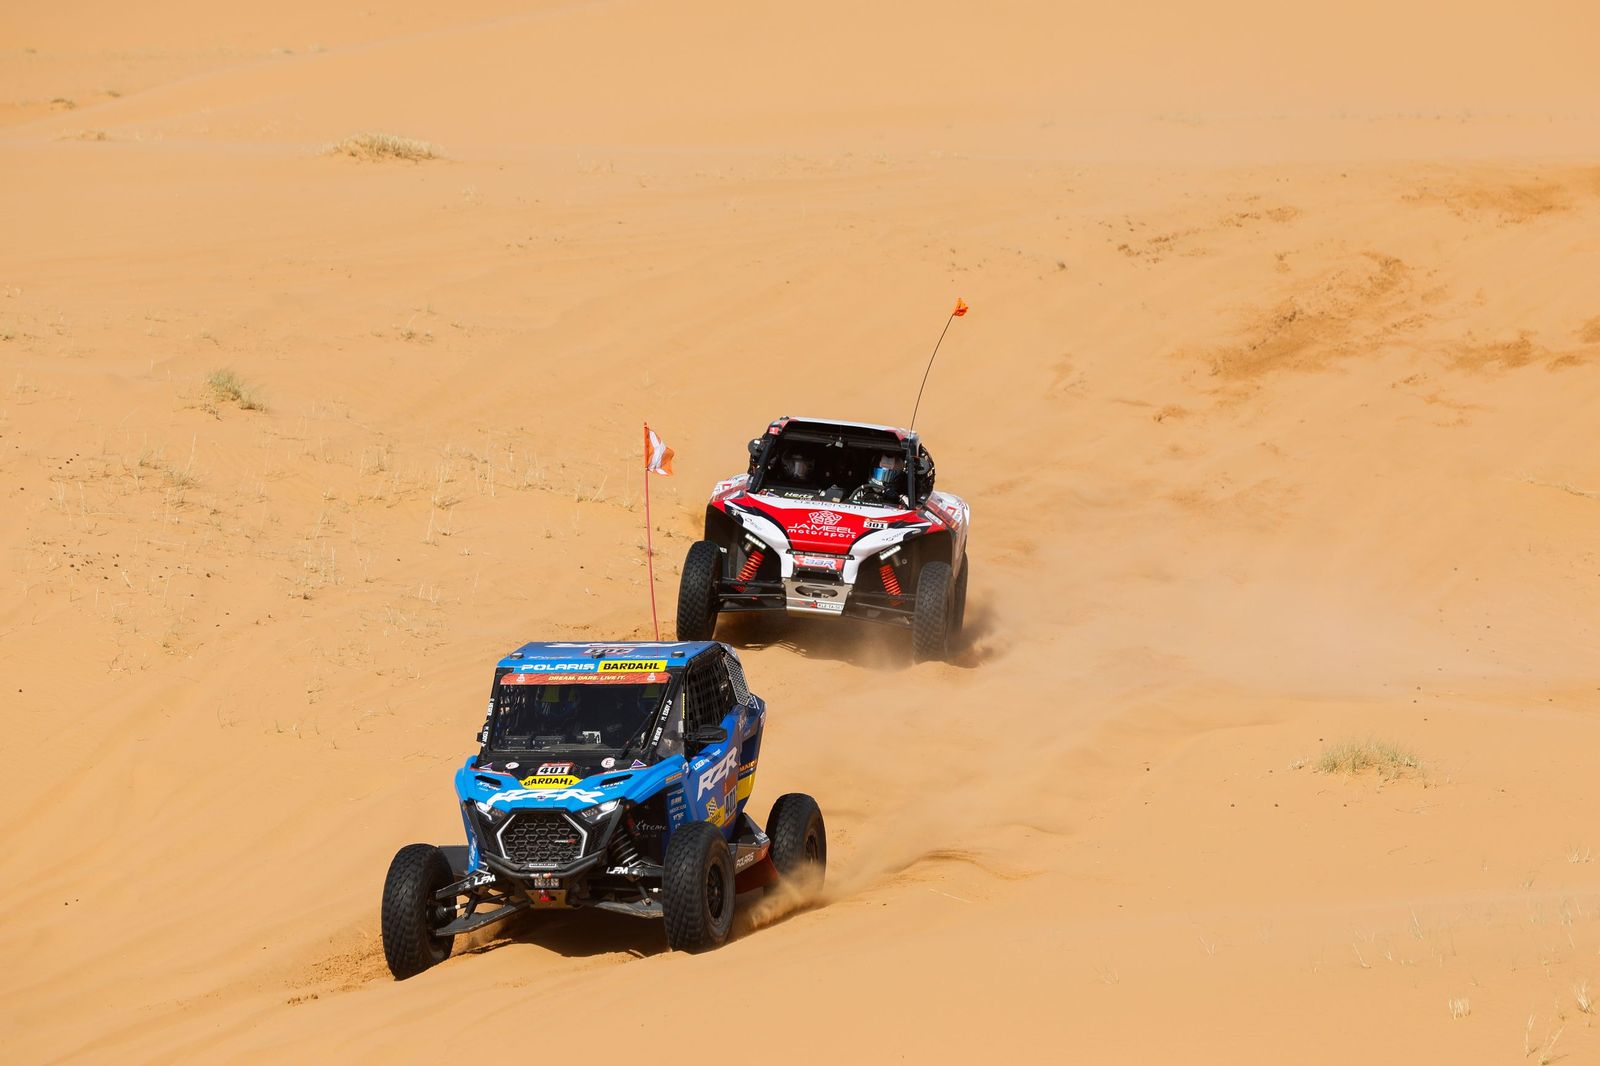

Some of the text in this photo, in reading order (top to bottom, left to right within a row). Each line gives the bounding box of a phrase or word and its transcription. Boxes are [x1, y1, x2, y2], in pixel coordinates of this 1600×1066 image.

[787, 523, 857, 535] JAMEEL
[787, 529, 857, 539] motorsport
[521, 662, 660, 671] POLARIS BARDAHL
[540, 766, 566, 774] 401
[697, 746, 738, 802] RZR
[606, 866, 630, 875] LFM
[474, 874, 496, 886] LFM
